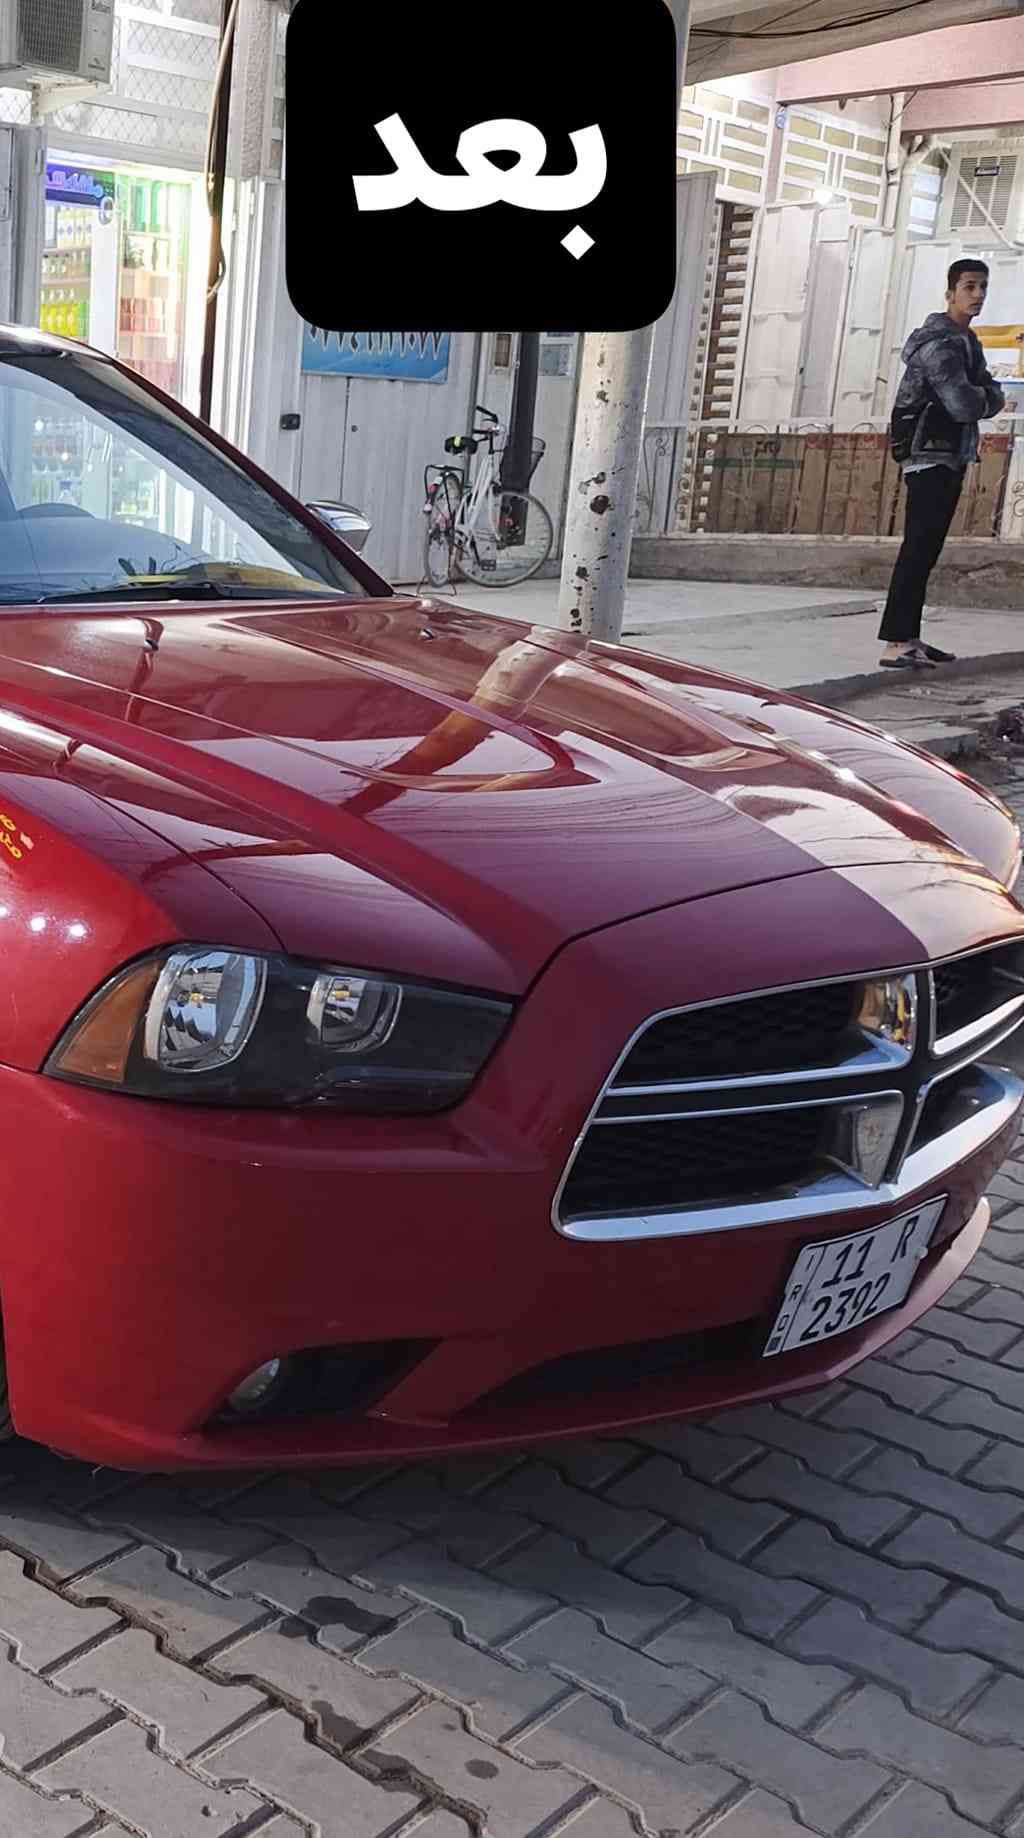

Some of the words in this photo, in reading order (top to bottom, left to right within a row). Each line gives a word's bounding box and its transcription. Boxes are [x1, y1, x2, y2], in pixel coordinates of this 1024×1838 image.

[821, 1236, 875, 1288] 11
[890, 1215, 919, 1263] R
[799, 1272, 891, 1342] 2392
